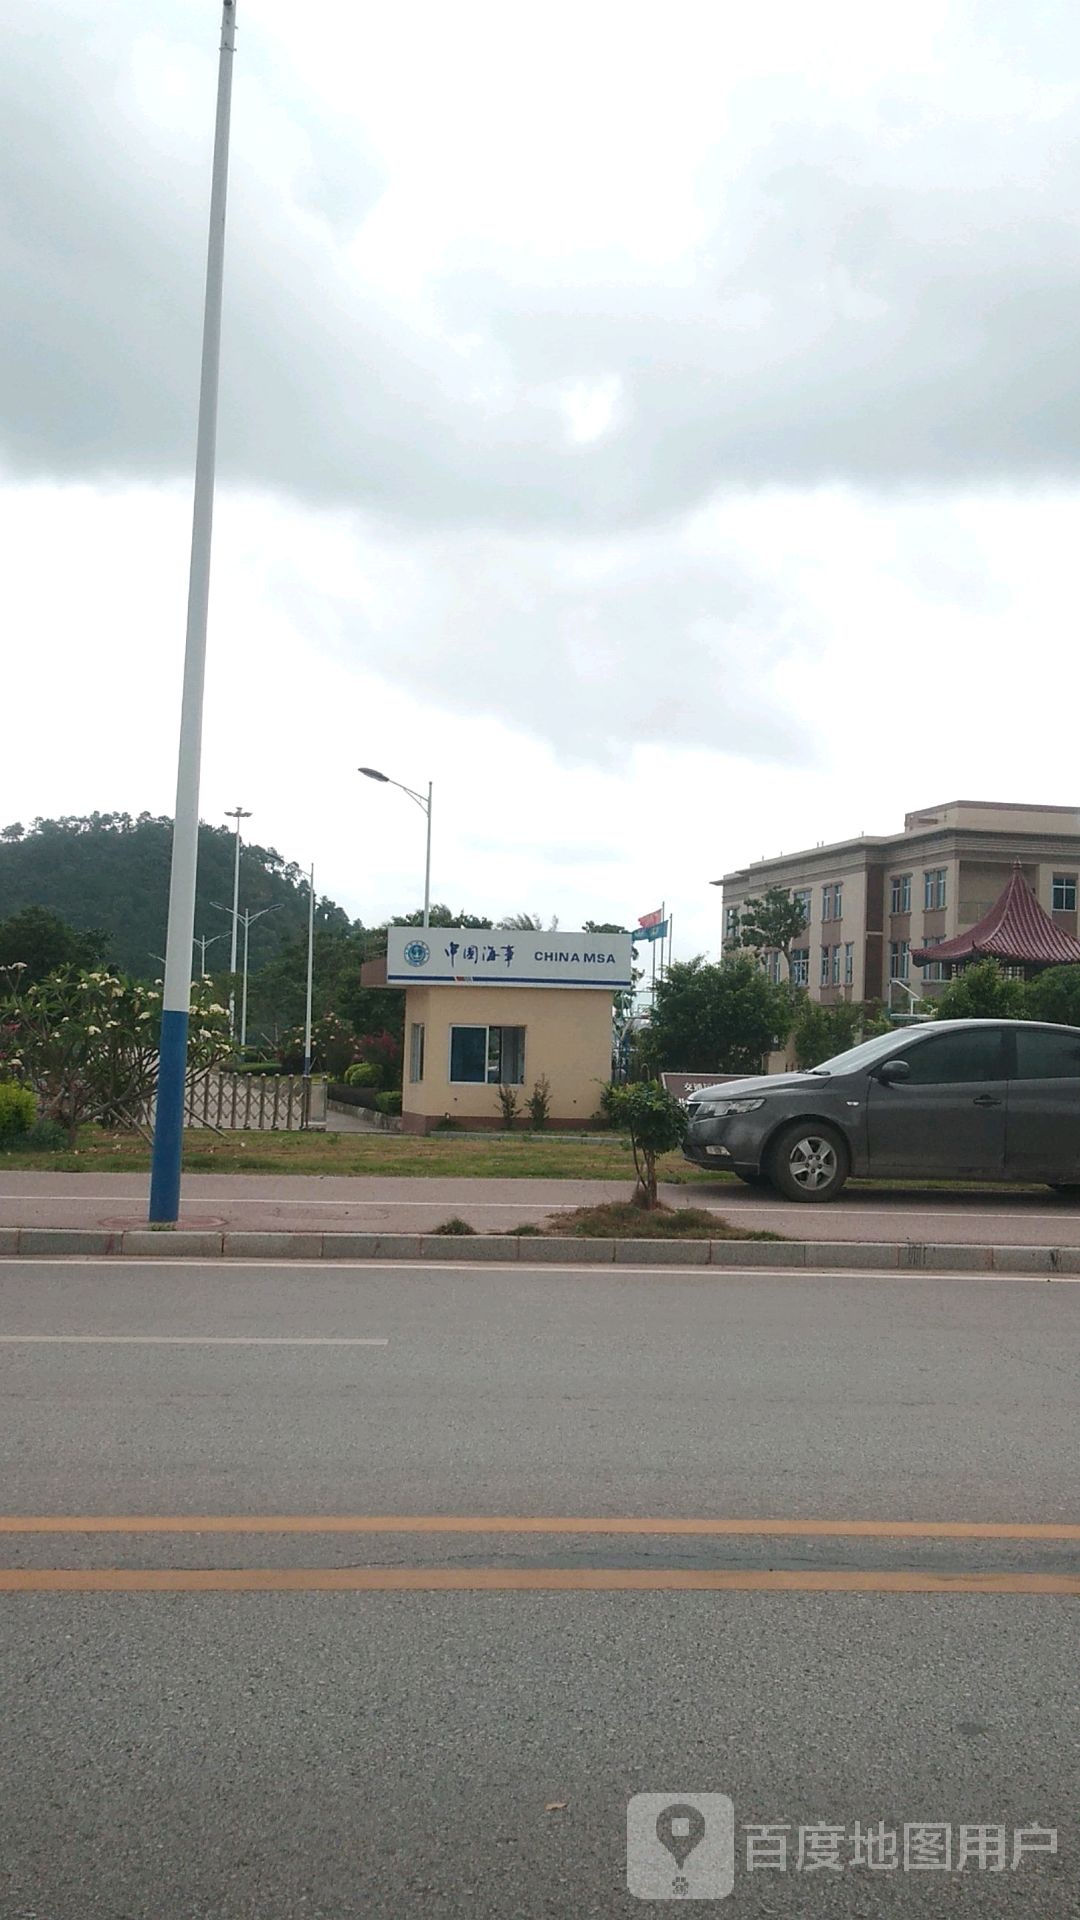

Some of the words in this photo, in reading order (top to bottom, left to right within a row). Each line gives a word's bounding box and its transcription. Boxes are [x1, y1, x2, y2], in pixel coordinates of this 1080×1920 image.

[444, 941, 515, 968] 中国海事
[534, 951, 580, 963] CHINA
[583, 952, 616, 965] MSA
